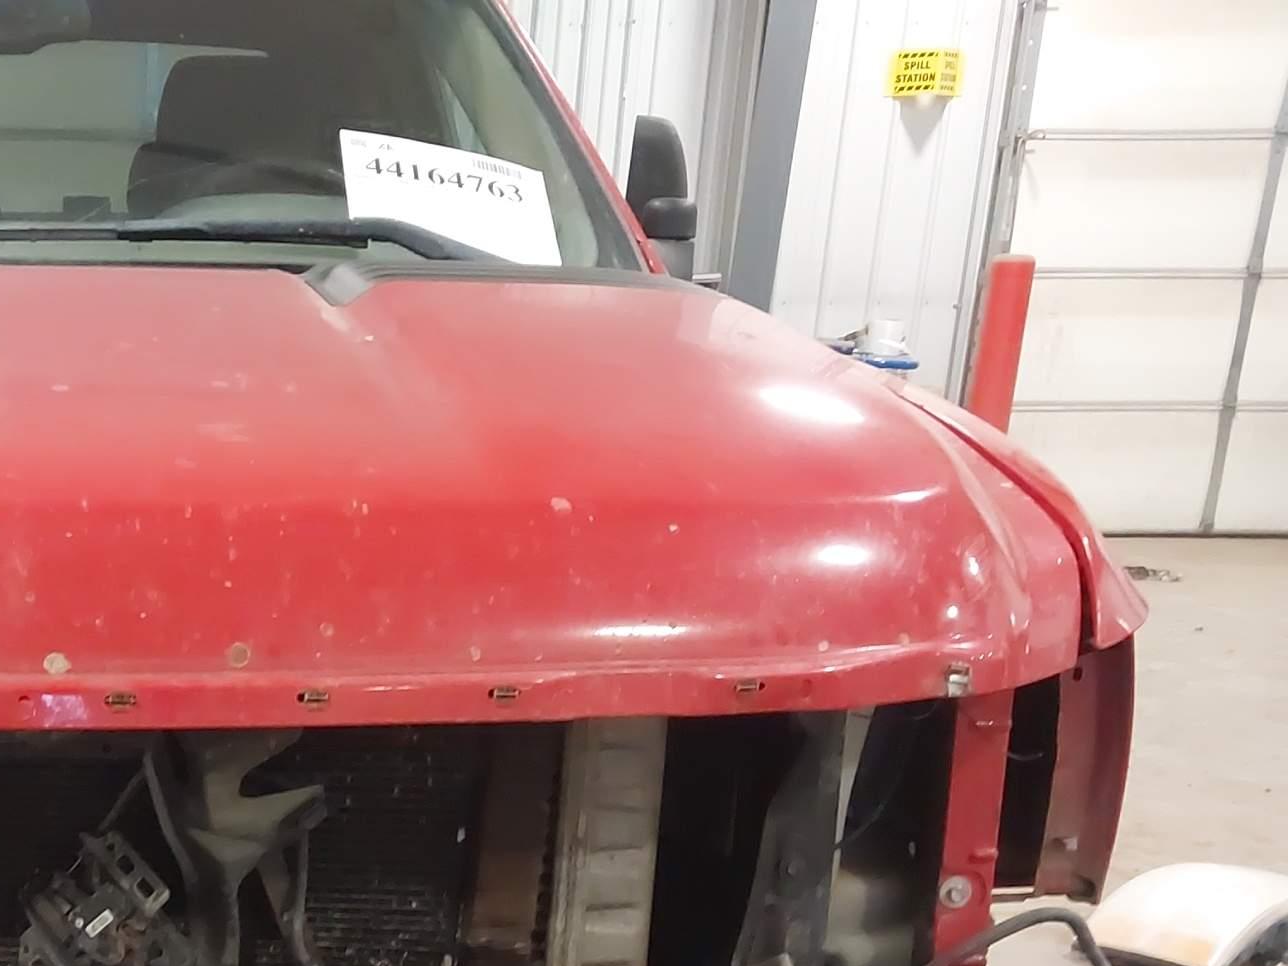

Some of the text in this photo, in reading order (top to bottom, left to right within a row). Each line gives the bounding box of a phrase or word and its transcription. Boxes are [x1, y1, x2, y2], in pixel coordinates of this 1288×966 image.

[903, 60, 931, 71] SPILL
[895, 72, 936, 83] STATION
[365, 157, 524, 202] 44164763
